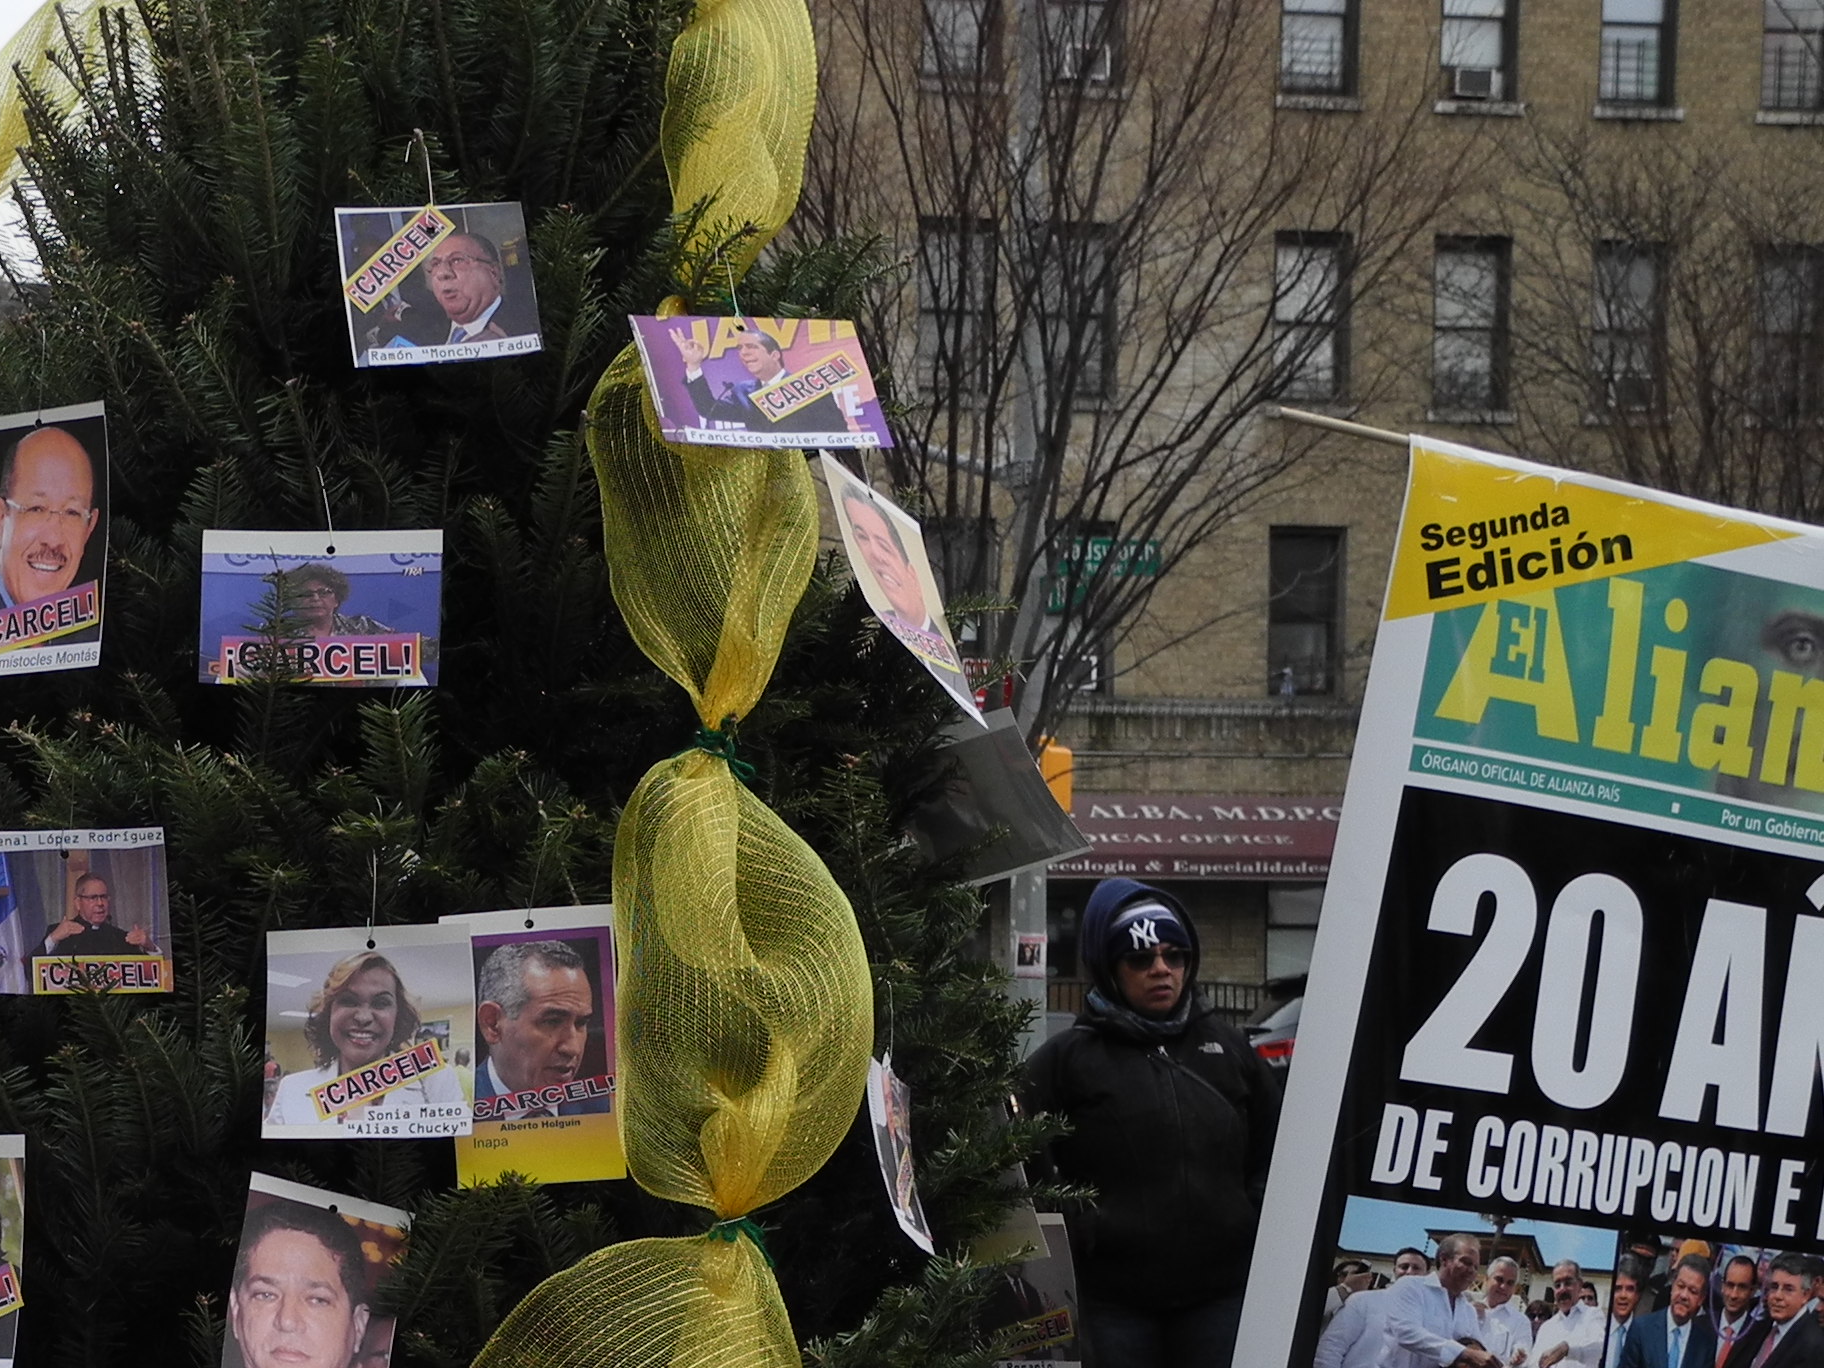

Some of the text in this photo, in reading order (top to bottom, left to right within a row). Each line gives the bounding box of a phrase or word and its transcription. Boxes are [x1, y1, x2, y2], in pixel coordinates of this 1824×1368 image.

[352, 214, 448, 307] ¡CARCEL!
[371, 348, 413, 363] Ramón
[498, 338, 540, 353] Fadul
[760, 358, 856, 418] ¡CARCEL!
[690, 430, 877, 446] Francisco Javier García
[1420, 502, 1570, 552] Segunda
[1426, 532, 1633, 600] Edición
[55, 648, 98, 666] Montás
[1490, 599, 1549, 683] El
[1421, 749, 1621, 803] ÓRGANO OFICIAL DE ALIANZA PAÍS
[1090, 804, 1203, 822] ALBA,
[37, 832, 80, 848] López
[88, 830, 163, 846] Rodríguez
[1179, 833, 1294, 845] OFFICE
[1129, 917, 1160, 950] NY
[1400, 852, 1643, 1110] 20
[319, 1046, 438, 1114] ¡CARCEL!
[367, 1106, 462, 1122] Sonia Mateo
[500, 1121, 539, 1132] Alberto
[473, 1137, 509, 1149] Inapa
[1371, 1103, 1806, 1237] DE CORRUPCION E
